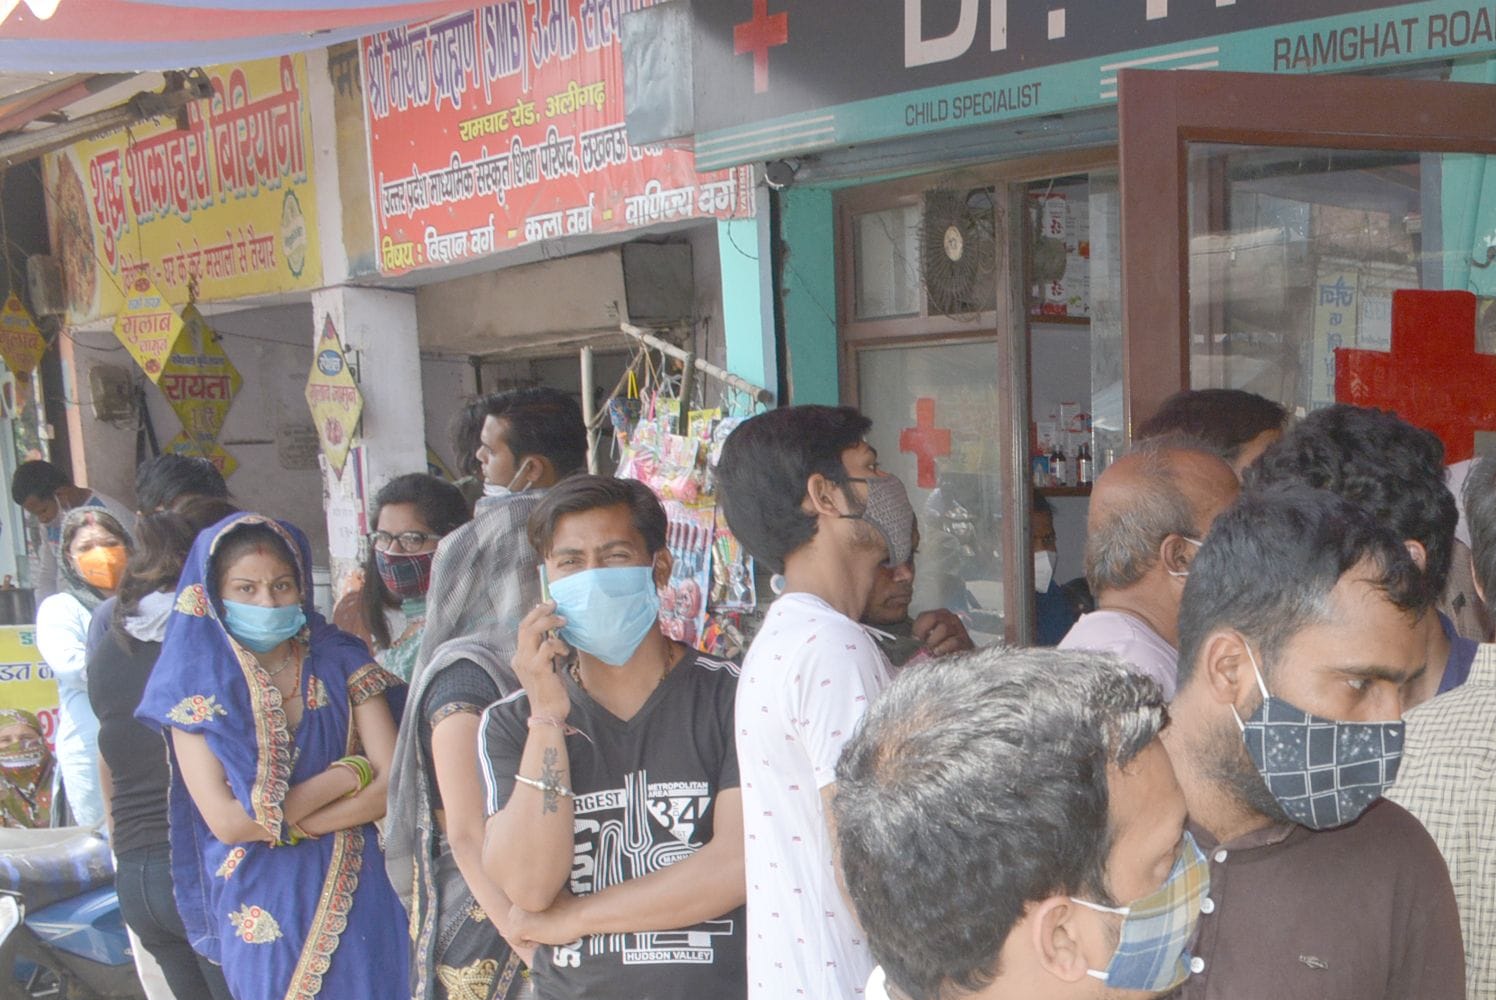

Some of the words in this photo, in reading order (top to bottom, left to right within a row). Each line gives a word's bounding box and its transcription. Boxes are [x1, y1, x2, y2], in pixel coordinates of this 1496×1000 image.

[1273, 17, 1418, 72] RAMGHAT
[458, 109, 511, 142] रामघाट
[545, 80, 606, 119] अलीगढ़
[904, 99, 949, 127] CHILD
[952, 82, 1042, 119] SPECIALIST
[511, 135, 541, 188] शिक्षा
[90, 148, 131, 275] शुद्ध
[124, 100, 215, 222] शाकाहारी
[381, 235, 416, 272] विषय
[424, 226, 469, 263] विज्ञान
[469, 213, 496, 254] वर्ग
[565, 191, 596, 236] वर्ग
[624, 179, 695, 226] वाणिज्य
[121, 312, 171, 345] गुलाब
[164, 373, 231, 401] रायता
[573, 791, 621, 814] RGEST
[647, 782, 709, 792] METROPOLITAN
[626, 952, 672, 961] HUDSON
[673, 950, 711, 961] VALLEY
